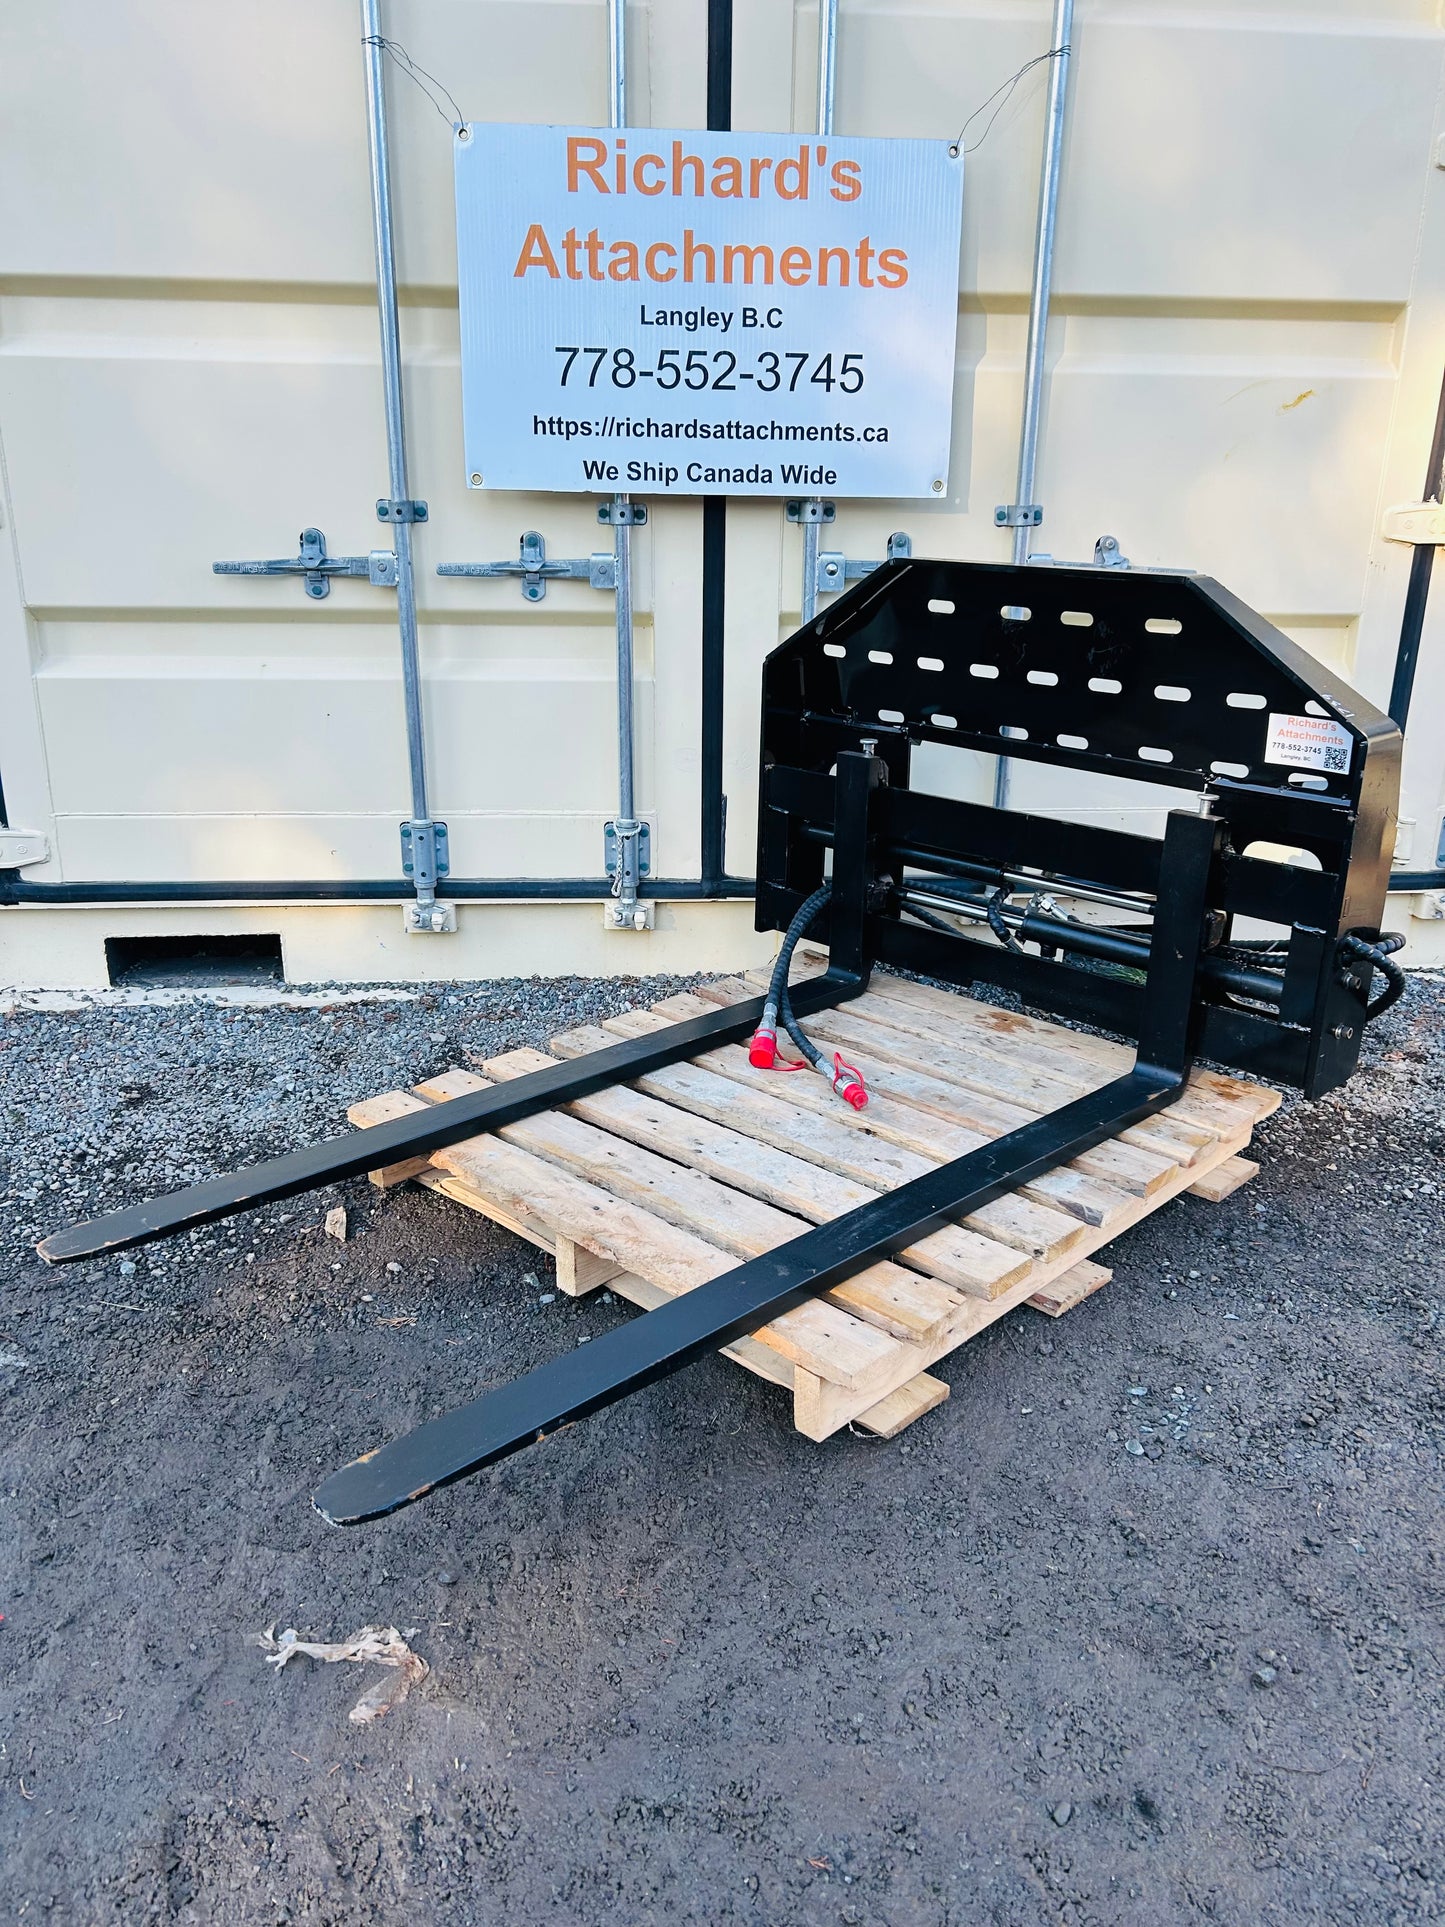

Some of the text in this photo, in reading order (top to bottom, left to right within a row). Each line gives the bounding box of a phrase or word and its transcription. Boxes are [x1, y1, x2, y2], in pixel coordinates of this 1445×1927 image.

[566, 137, 863, 202] Richard's
[513, 223, 910, 289] Attachments
[640, 304, 784, 333] Langley B.C
[555, 346, 865, 394] 778-552-3745
[533, 415, 890, 443] https://richardsattachments.ca
[582, 460, 838, 487] We Ship Canada Wide
[1277, 728, 1344, 746] Attachments
[1287, 717, 1337, 732] Richard's
[1272, 741, 1322, 755] 778-552-3745
